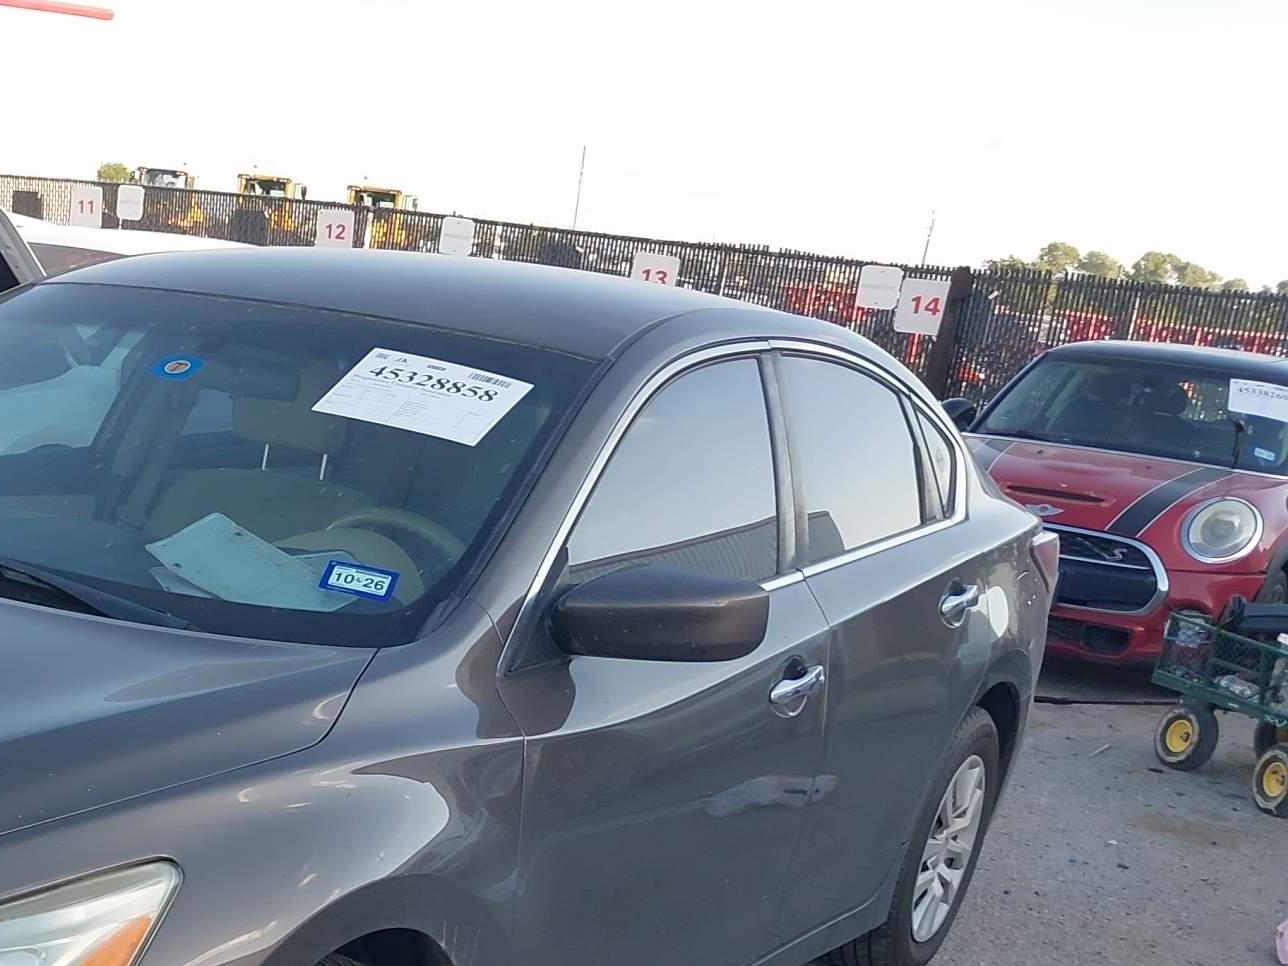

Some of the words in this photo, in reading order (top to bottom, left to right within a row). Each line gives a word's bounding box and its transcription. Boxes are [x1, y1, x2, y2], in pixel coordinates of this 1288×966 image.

[77, 199, 95, 214] 11
[325, 223, 347, 241] 12
[641, 268, 668, 285] 13
[910, 295, 941, 316] 14
[368, 365, 499, 402] 45328858
